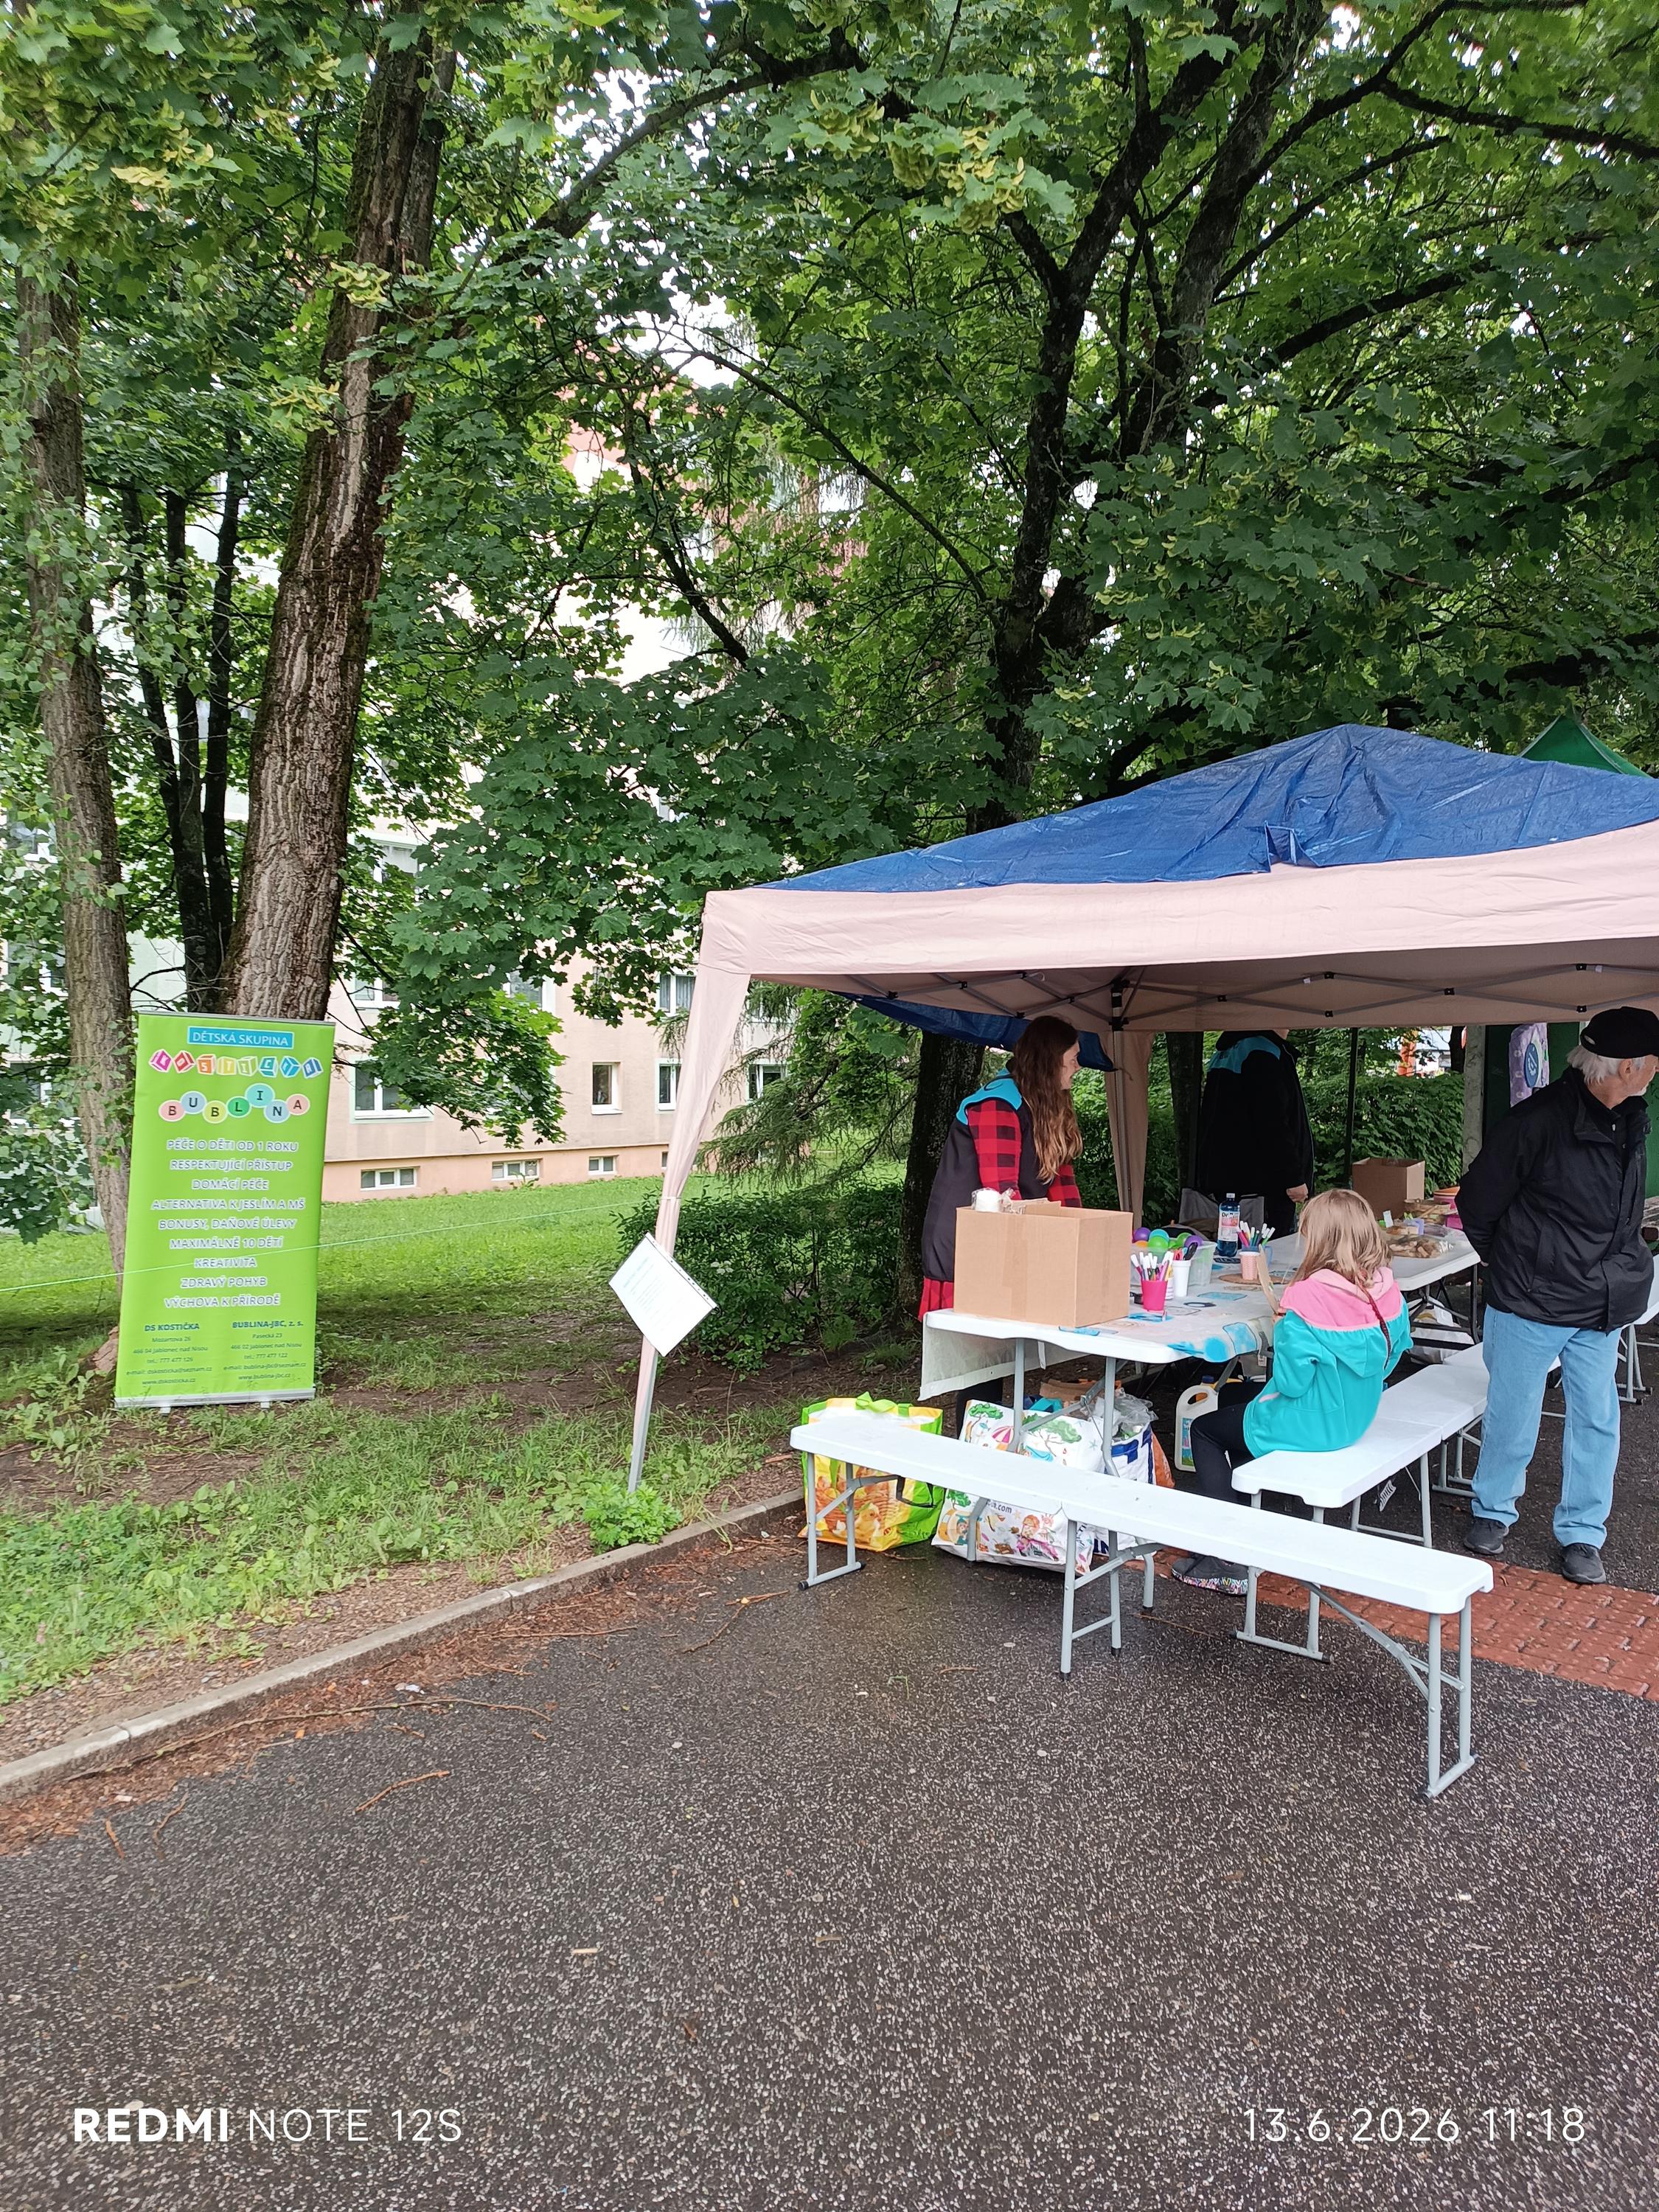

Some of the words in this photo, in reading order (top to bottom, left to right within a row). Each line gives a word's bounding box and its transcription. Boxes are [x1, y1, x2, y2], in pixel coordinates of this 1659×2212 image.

[192, 1031, 236, 1043] DĚTSKÁ
[238, 1034, 288, 1046] SKUPINA
[166, 1089, 305, 1119] BUBLINA
[167, 1138, 195, 1150] PÉČE
[198, 1141, 206, 1150] O
[209, 1138, 234, 1150] DĚTI
[237, 1141, 254, 1150] OD
[257, 1141, 263, 1150] 1
[266, 1141, 298, 1151] ROKU
[170, 1158, 245, 1171] RESPEKTUJÍCÍ
[247, 1159, 293, 1171] PŘÍSTUP
[192, 1178, 239, 1189] DOMÁCÍ
[241, 1178, 269, 1189] PÉČE
[152, 1200, 226, 1209] ALTERNATIVA
[229, 1200, 237, 1209] K
[238, 1197, 275, 1211] JESLÍM
[276, 1200, 286, 1209] A
[288, 1197, 305, 1209] MŠ
[159, 1220, 209, 1230] BONUSY,
[211, 1217, 260, 1228] DAŇOVÉ
[261, 1218, 296, 1228] ÚLEVY
[170, 1237, 240, 1248] MAXIMÁLNĚ
[243, 1238, 255, 1248] 10
[257, 1236, 283, 1248] DĚTÍ
[194, 1257, 257, 1267] KREATIVITA
[181, 1276, 226, 1287] ZDRAVÝ
[228, 1276, 267, 1287] POHYB
[164, 1295, 219, 1307] VÝCHOVA
[221, 1297, 229, 1306] K
[232, 1293, 280, 1306] PŘÍRODĚ
[158, 1322, 200, 1331] KOSTIČKA
